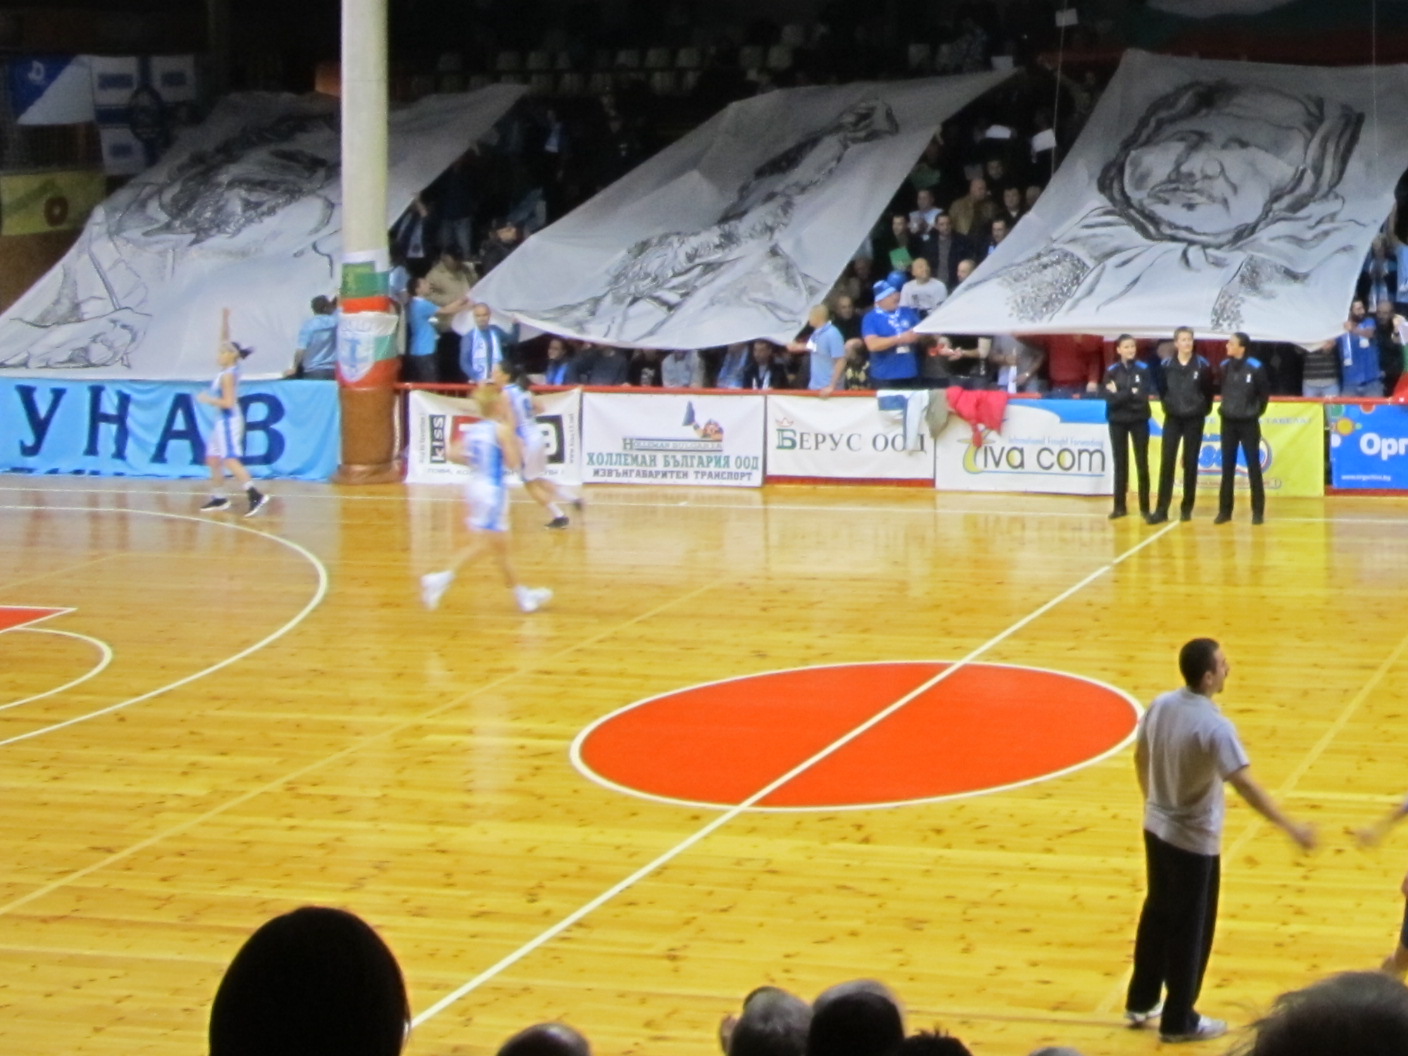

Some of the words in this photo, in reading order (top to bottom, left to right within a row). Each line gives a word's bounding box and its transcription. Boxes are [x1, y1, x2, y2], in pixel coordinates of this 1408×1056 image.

[14, 384, 286, 466] УНАВ
[776, 428, 862, 451] БЕРУС
[586, 452, 658, 468] ХОЛЛЕМАН
[663, 453, 730, 469] БЪЛГАРИЯ
[735, 455, 759, 471] ООД
[1036, 445, 1106, 472] com
[593, 468, 688, 480] ИЗВЪНГАБАРИТЕН
[694, 470, 753, 481] ТРАНСПОРТ
